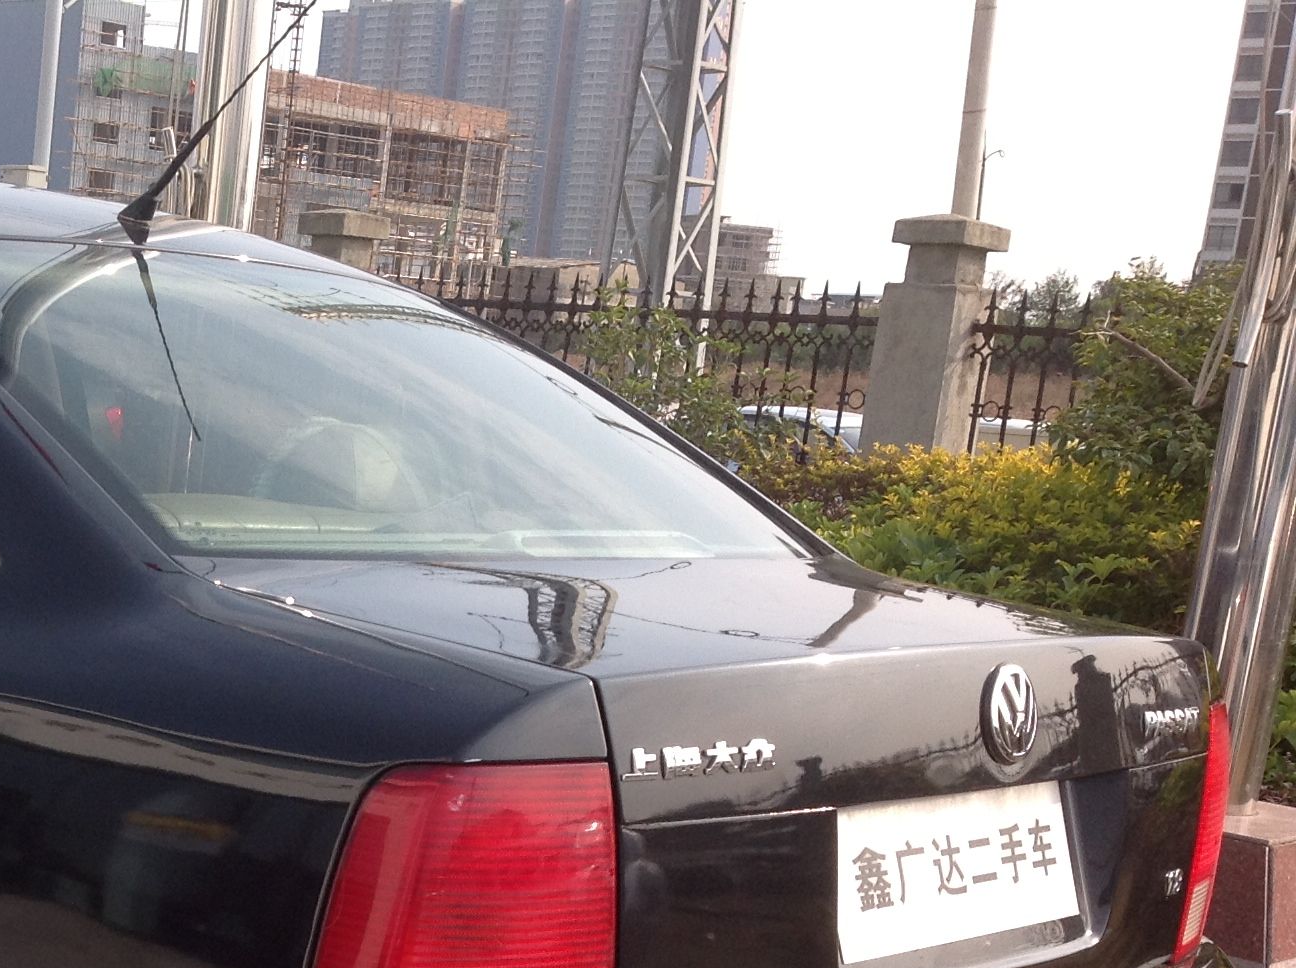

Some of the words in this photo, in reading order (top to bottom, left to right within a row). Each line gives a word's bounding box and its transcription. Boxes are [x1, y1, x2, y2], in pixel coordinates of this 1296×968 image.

[851, 818, 1058, 913] 鑫广达二手车
